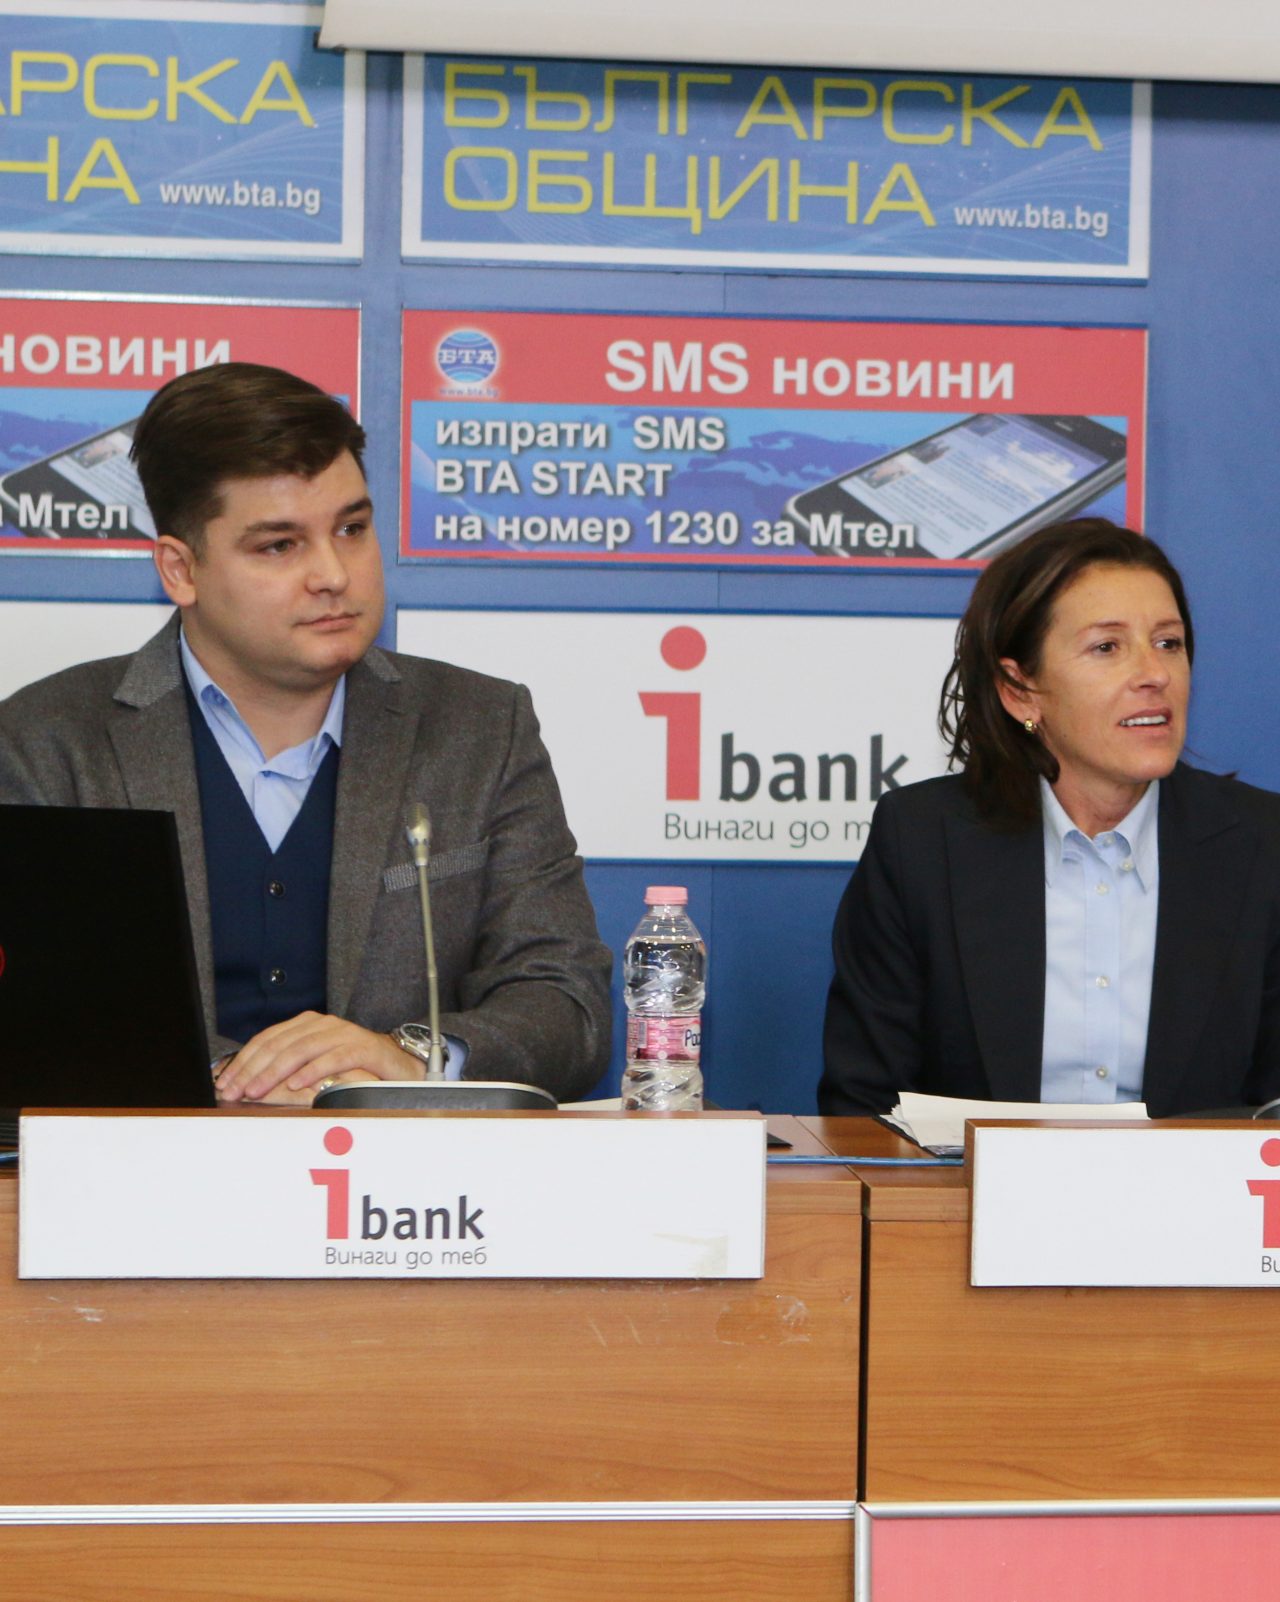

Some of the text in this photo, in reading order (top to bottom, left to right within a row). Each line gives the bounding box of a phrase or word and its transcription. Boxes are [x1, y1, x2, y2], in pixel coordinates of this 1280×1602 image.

[0, 50, 315, 128] РСКА
[444, 62, 1104, 151] БЪЛГАРСКА
[159, 181, 321, 215] www.bta.bg
[443, 146, 937, 235] ОБЩИНА
[954, 203, 1109, 237] www.bta.bg
[439, 349, 497, 364] БТА
[604, 340, 1015, 400] SMS новини
[436, 415, 726, 454] изпрати SMS
[436, 459, 673, 497] BTA START
[18, 493, 129, 530] Мтел
[435, 510, 915, 550] на номер 1230 за Мтел
[664, 812, 775, 841] Винаги
[789, 819, 830, 849] до
[325, 1246, 487, 1270] Винаги до теб
